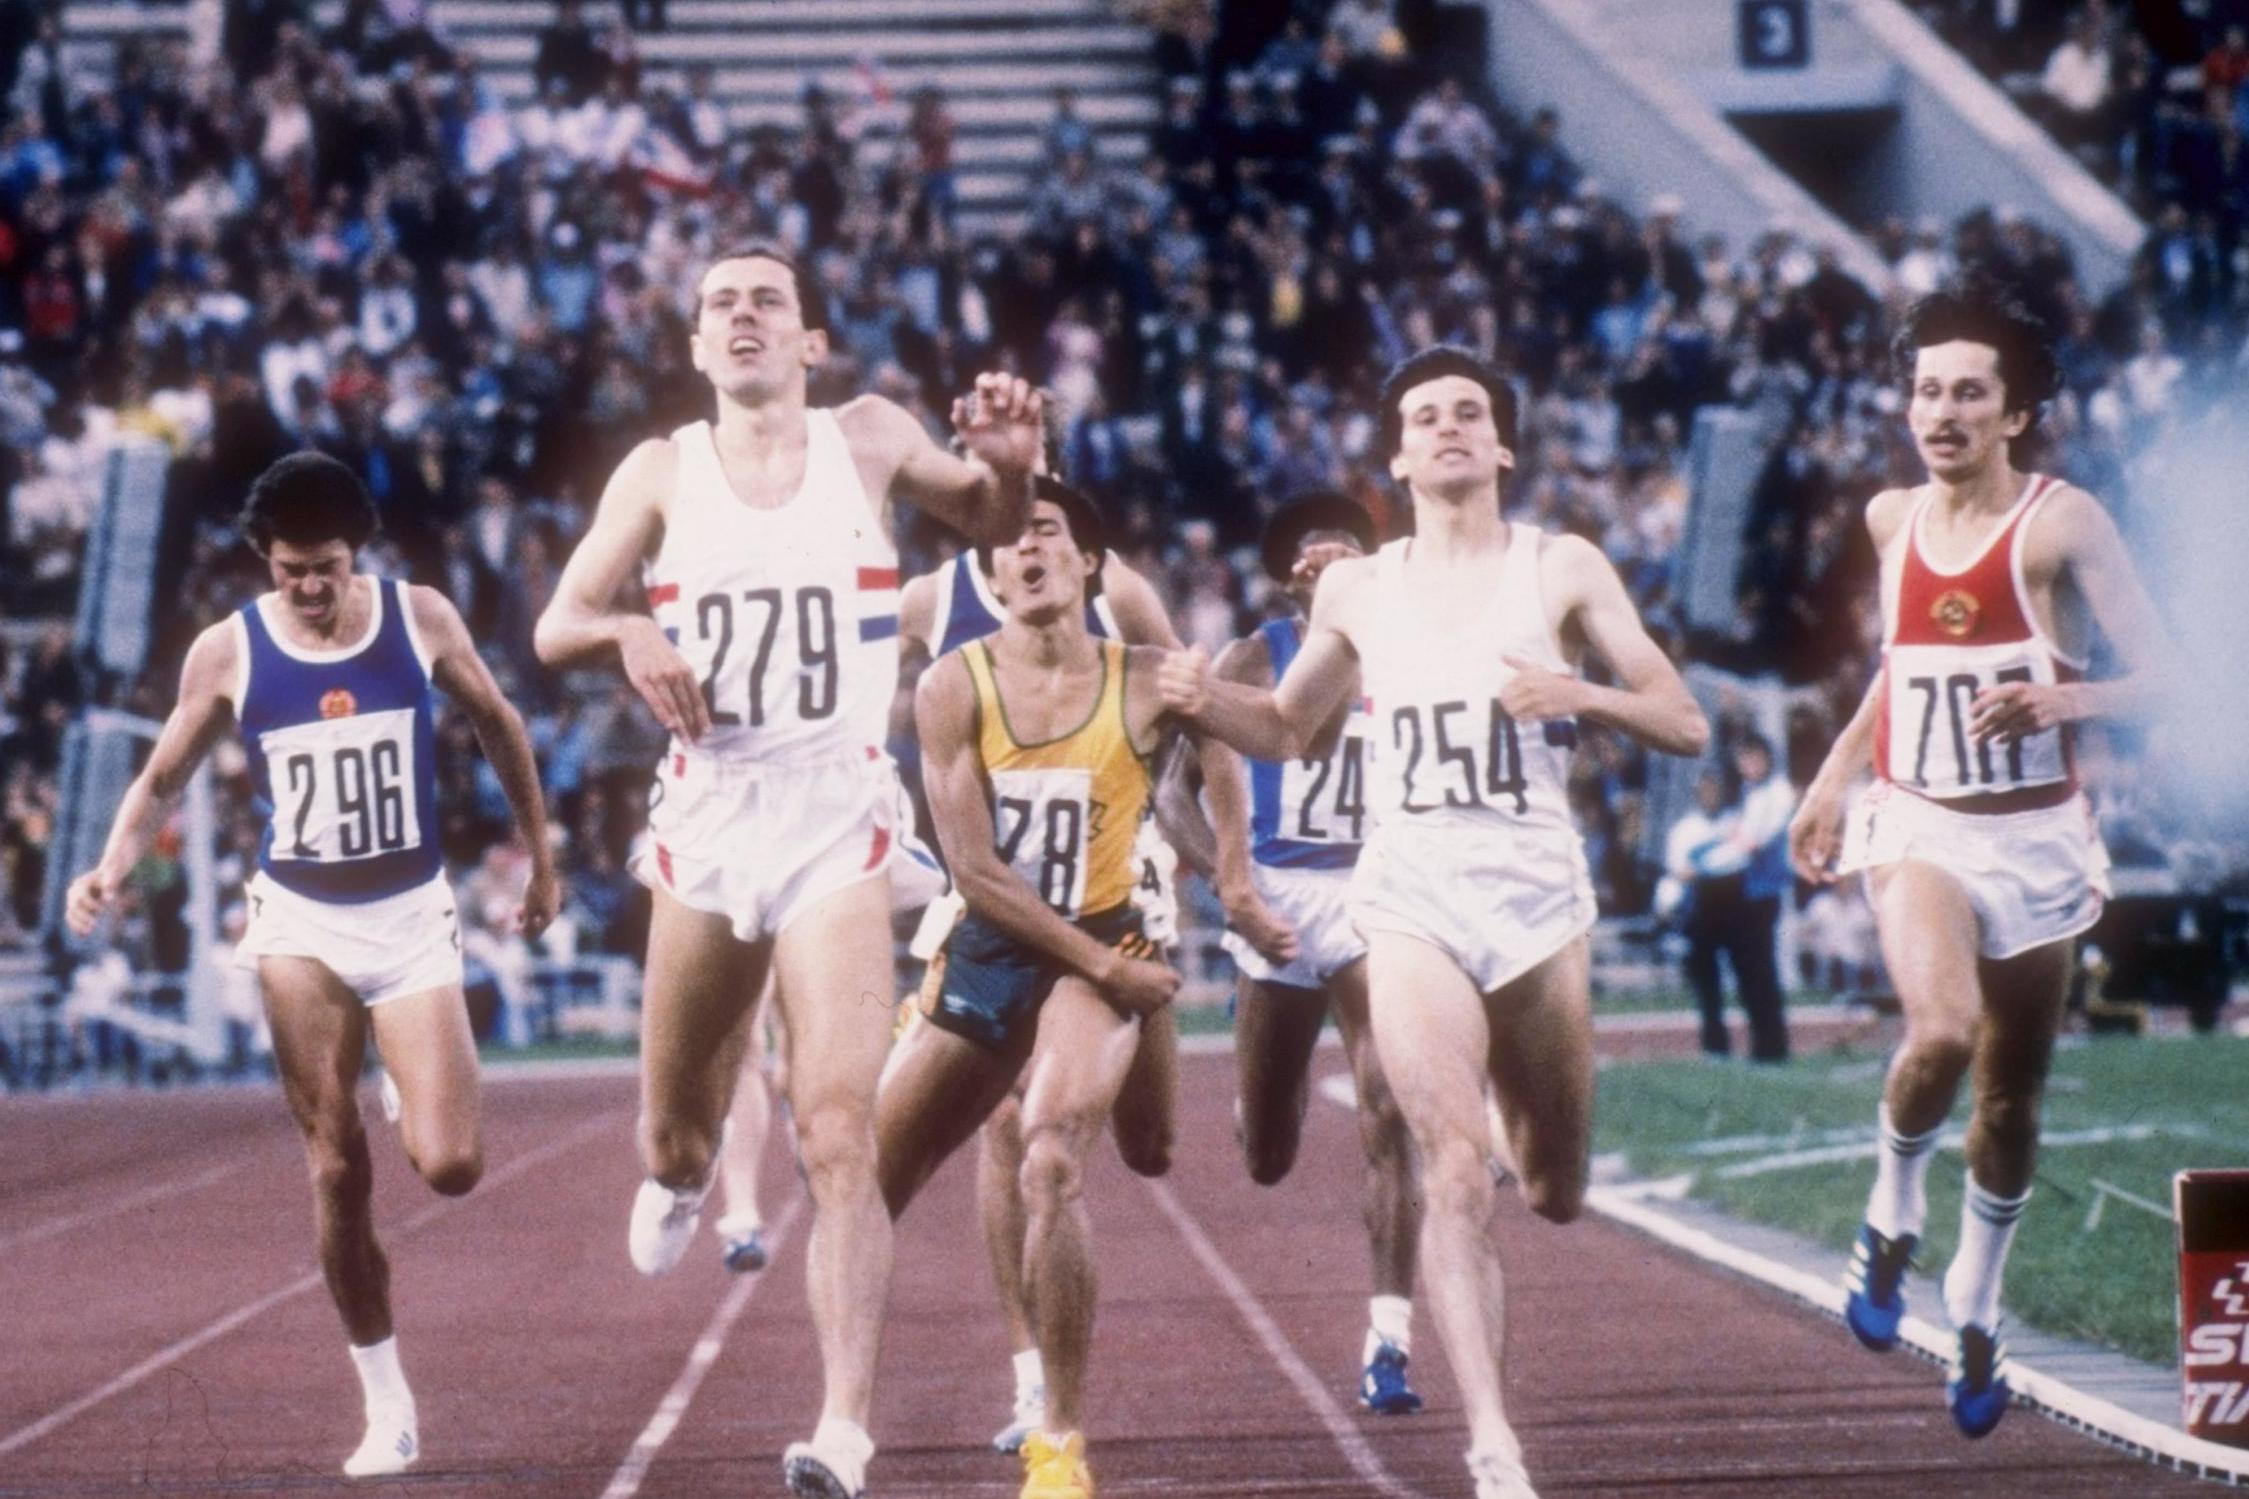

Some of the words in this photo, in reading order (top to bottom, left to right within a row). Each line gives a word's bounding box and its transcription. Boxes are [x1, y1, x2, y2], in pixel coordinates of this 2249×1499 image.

[1756, 5, 1793, 56] 3
[697, 586, 838, 727] 279
[287, 739, 406, 857] 296
[1392, 697, 1528, 814] 254
[996, 796, 1081, 916] 78
